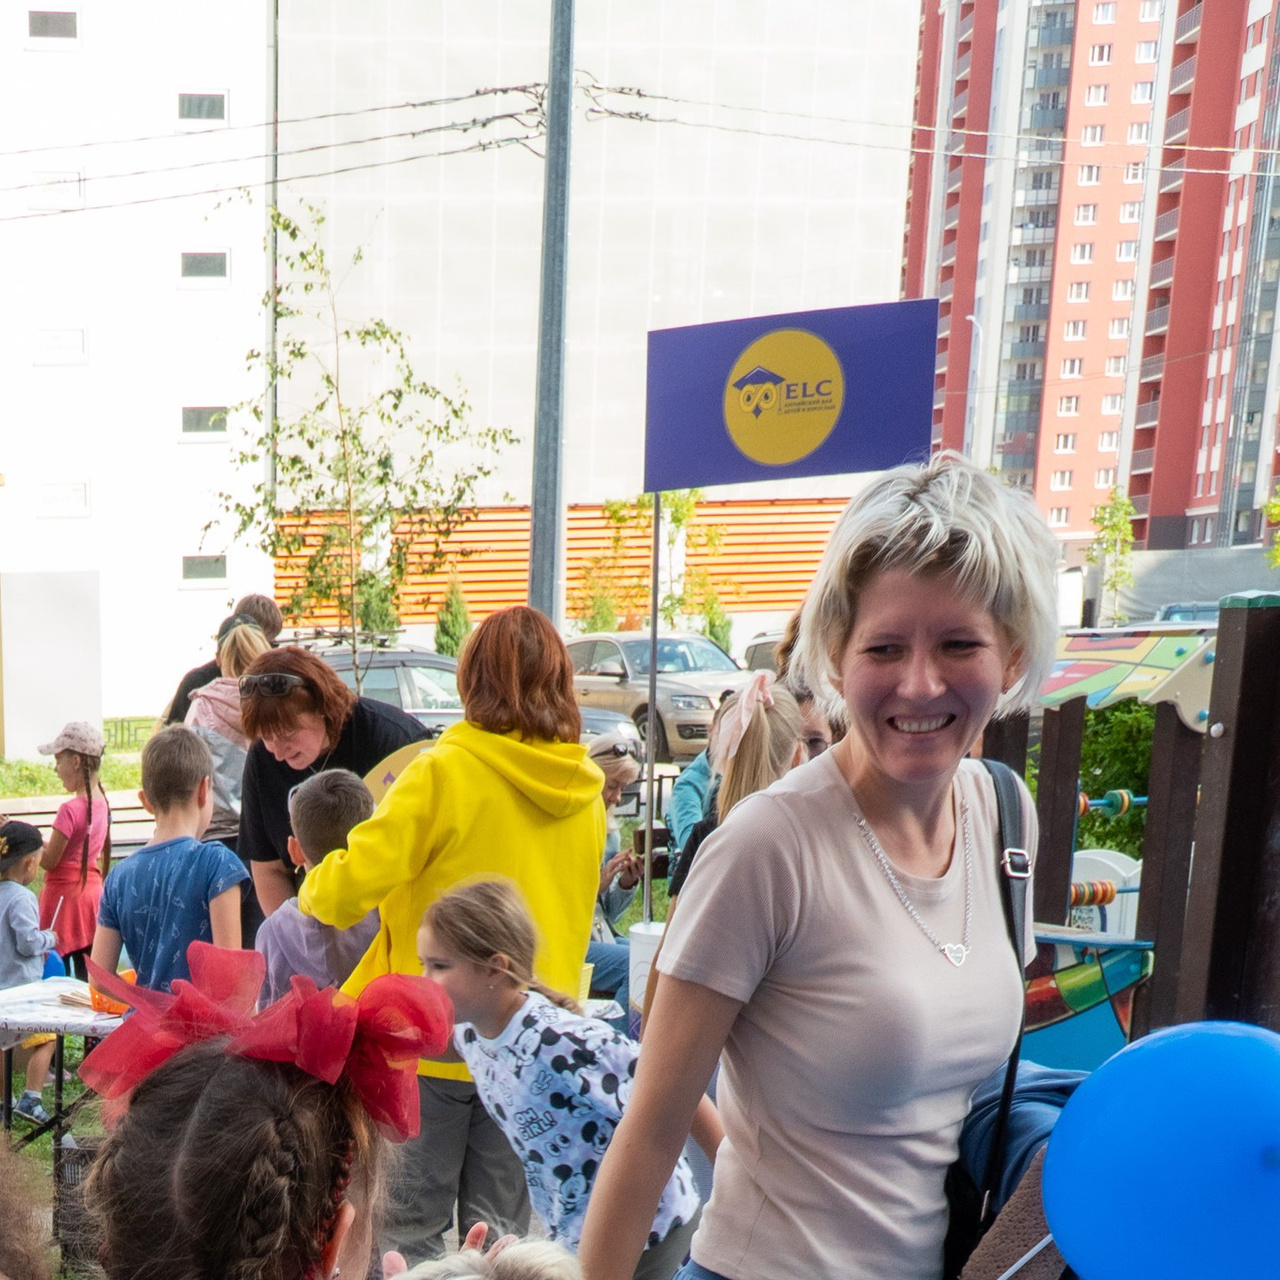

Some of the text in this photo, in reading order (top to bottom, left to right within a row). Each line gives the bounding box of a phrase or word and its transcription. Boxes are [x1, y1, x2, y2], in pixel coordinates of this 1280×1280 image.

[786, 379, 832, 400] ELC
[514, 1107, 538, 1126] OH
[518, 1111, 557, 1141] GIRL!
